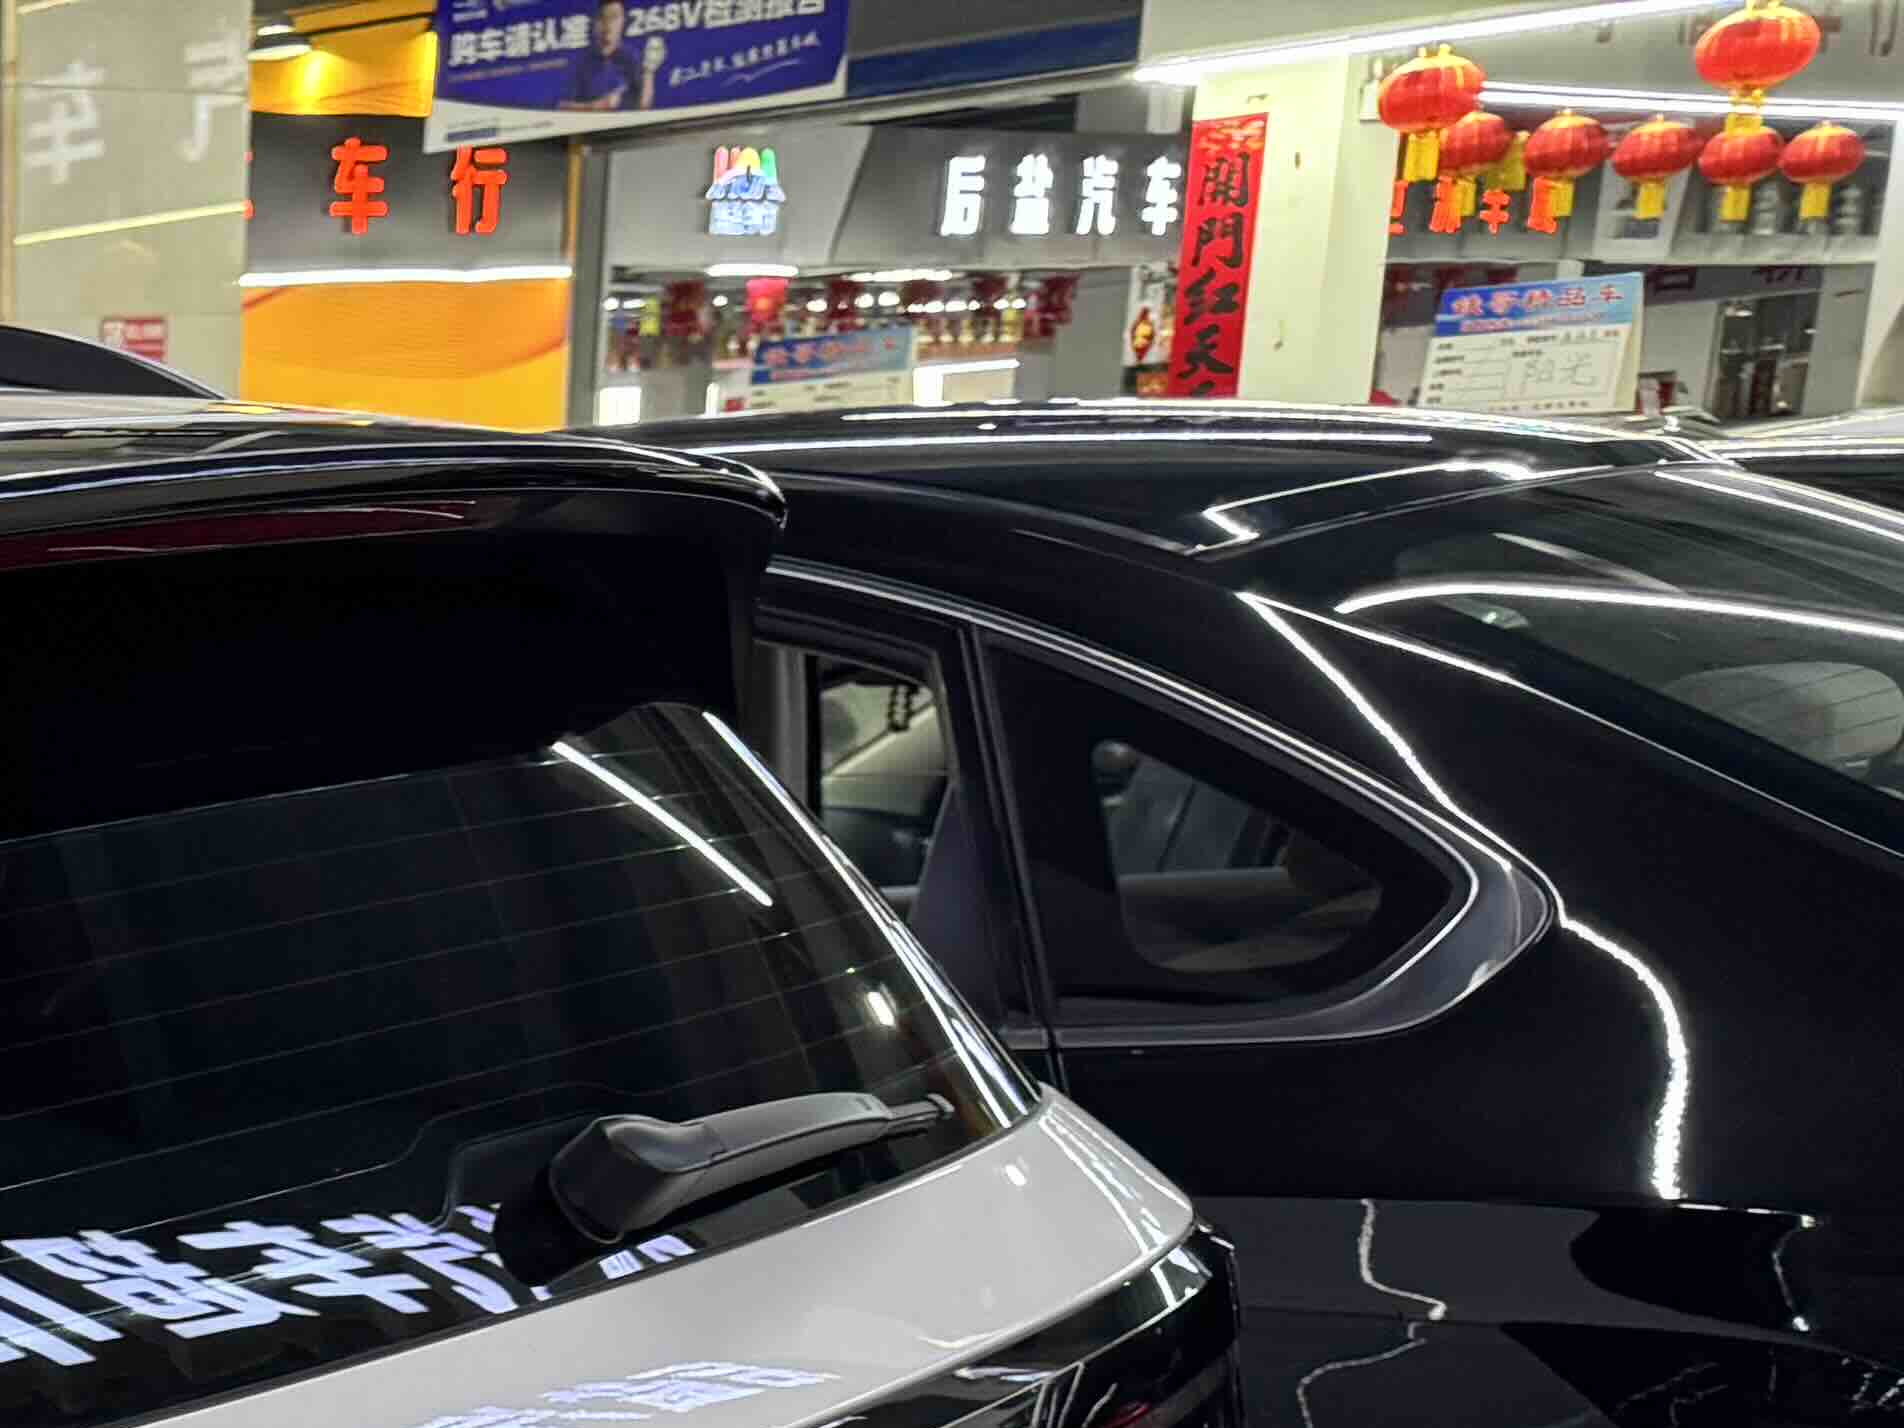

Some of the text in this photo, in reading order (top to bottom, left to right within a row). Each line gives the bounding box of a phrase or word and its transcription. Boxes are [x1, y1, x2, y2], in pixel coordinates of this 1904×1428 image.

[329, 137, 508, 234] 车行
[938, 152, 1183, 238] 后盐汽车
